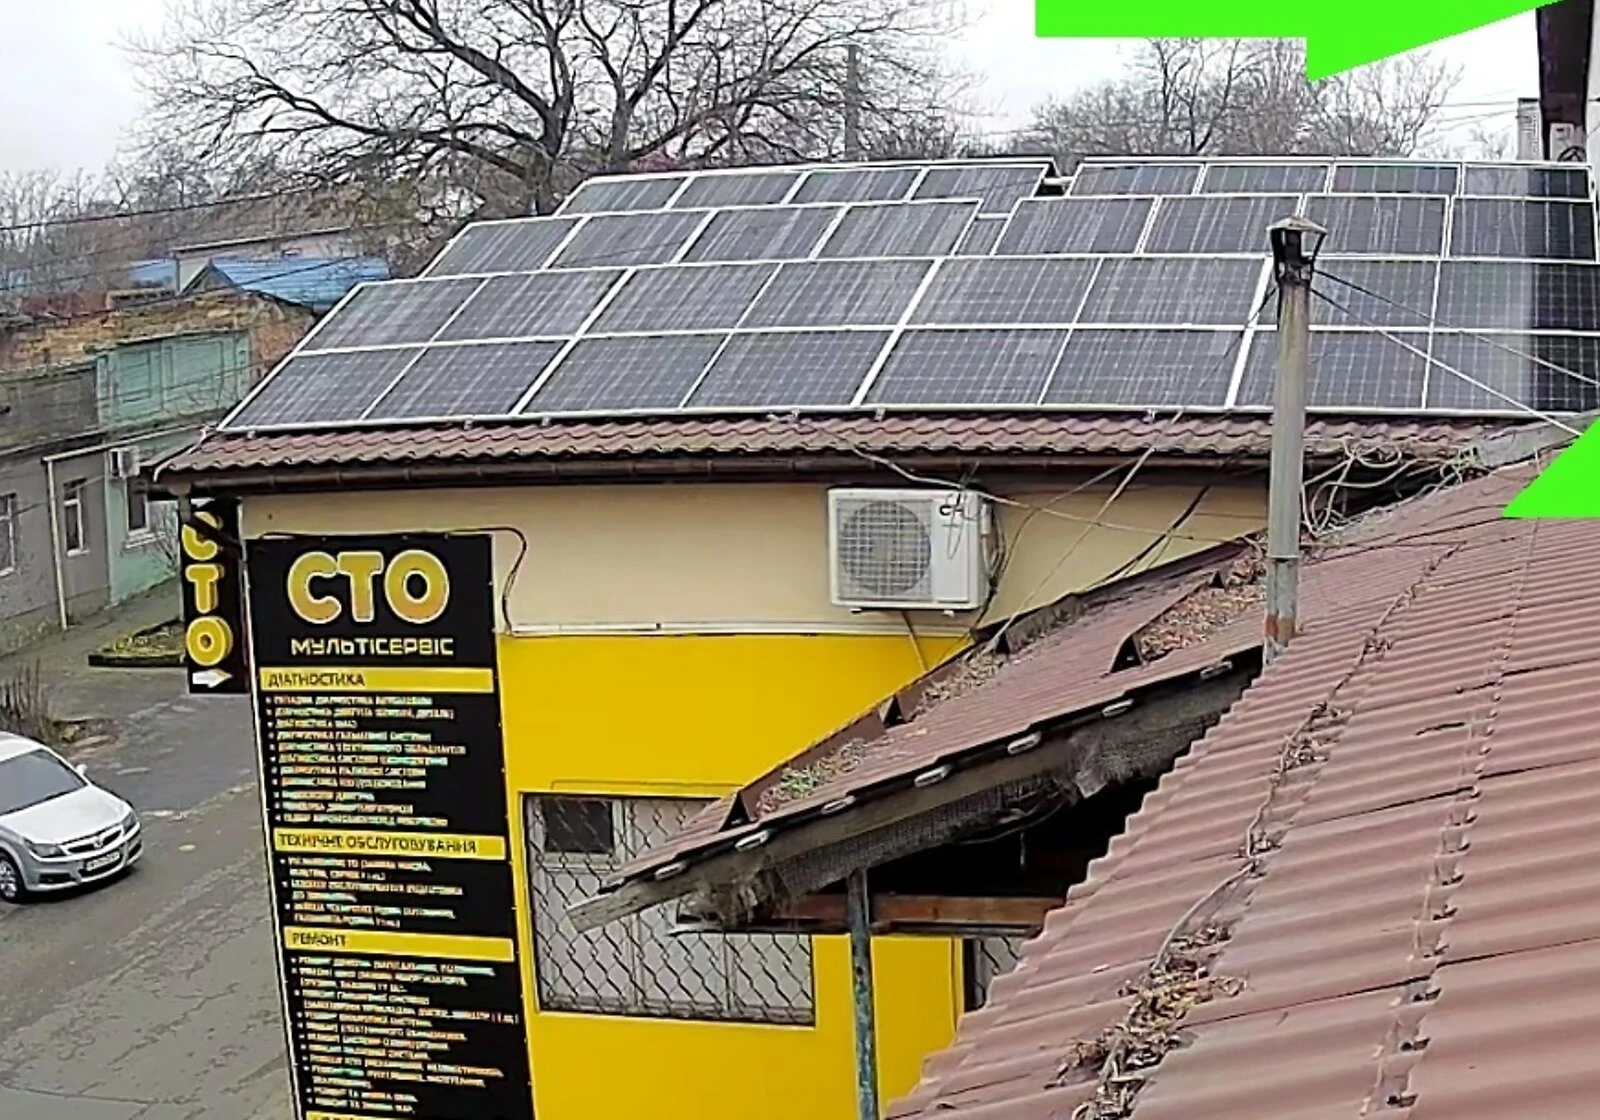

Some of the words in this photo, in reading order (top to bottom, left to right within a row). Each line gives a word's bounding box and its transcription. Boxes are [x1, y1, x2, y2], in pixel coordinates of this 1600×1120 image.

[182, 511, 233, 667] СТО
[287, 549, 450, 624] СТО
[291, 637, 454, 656] МУЛЬТІСЕРВІС
[267, 672, 366, 688] ДІАГНОСТИКА
[292, 932, 348, 947] РЕМОНТ
